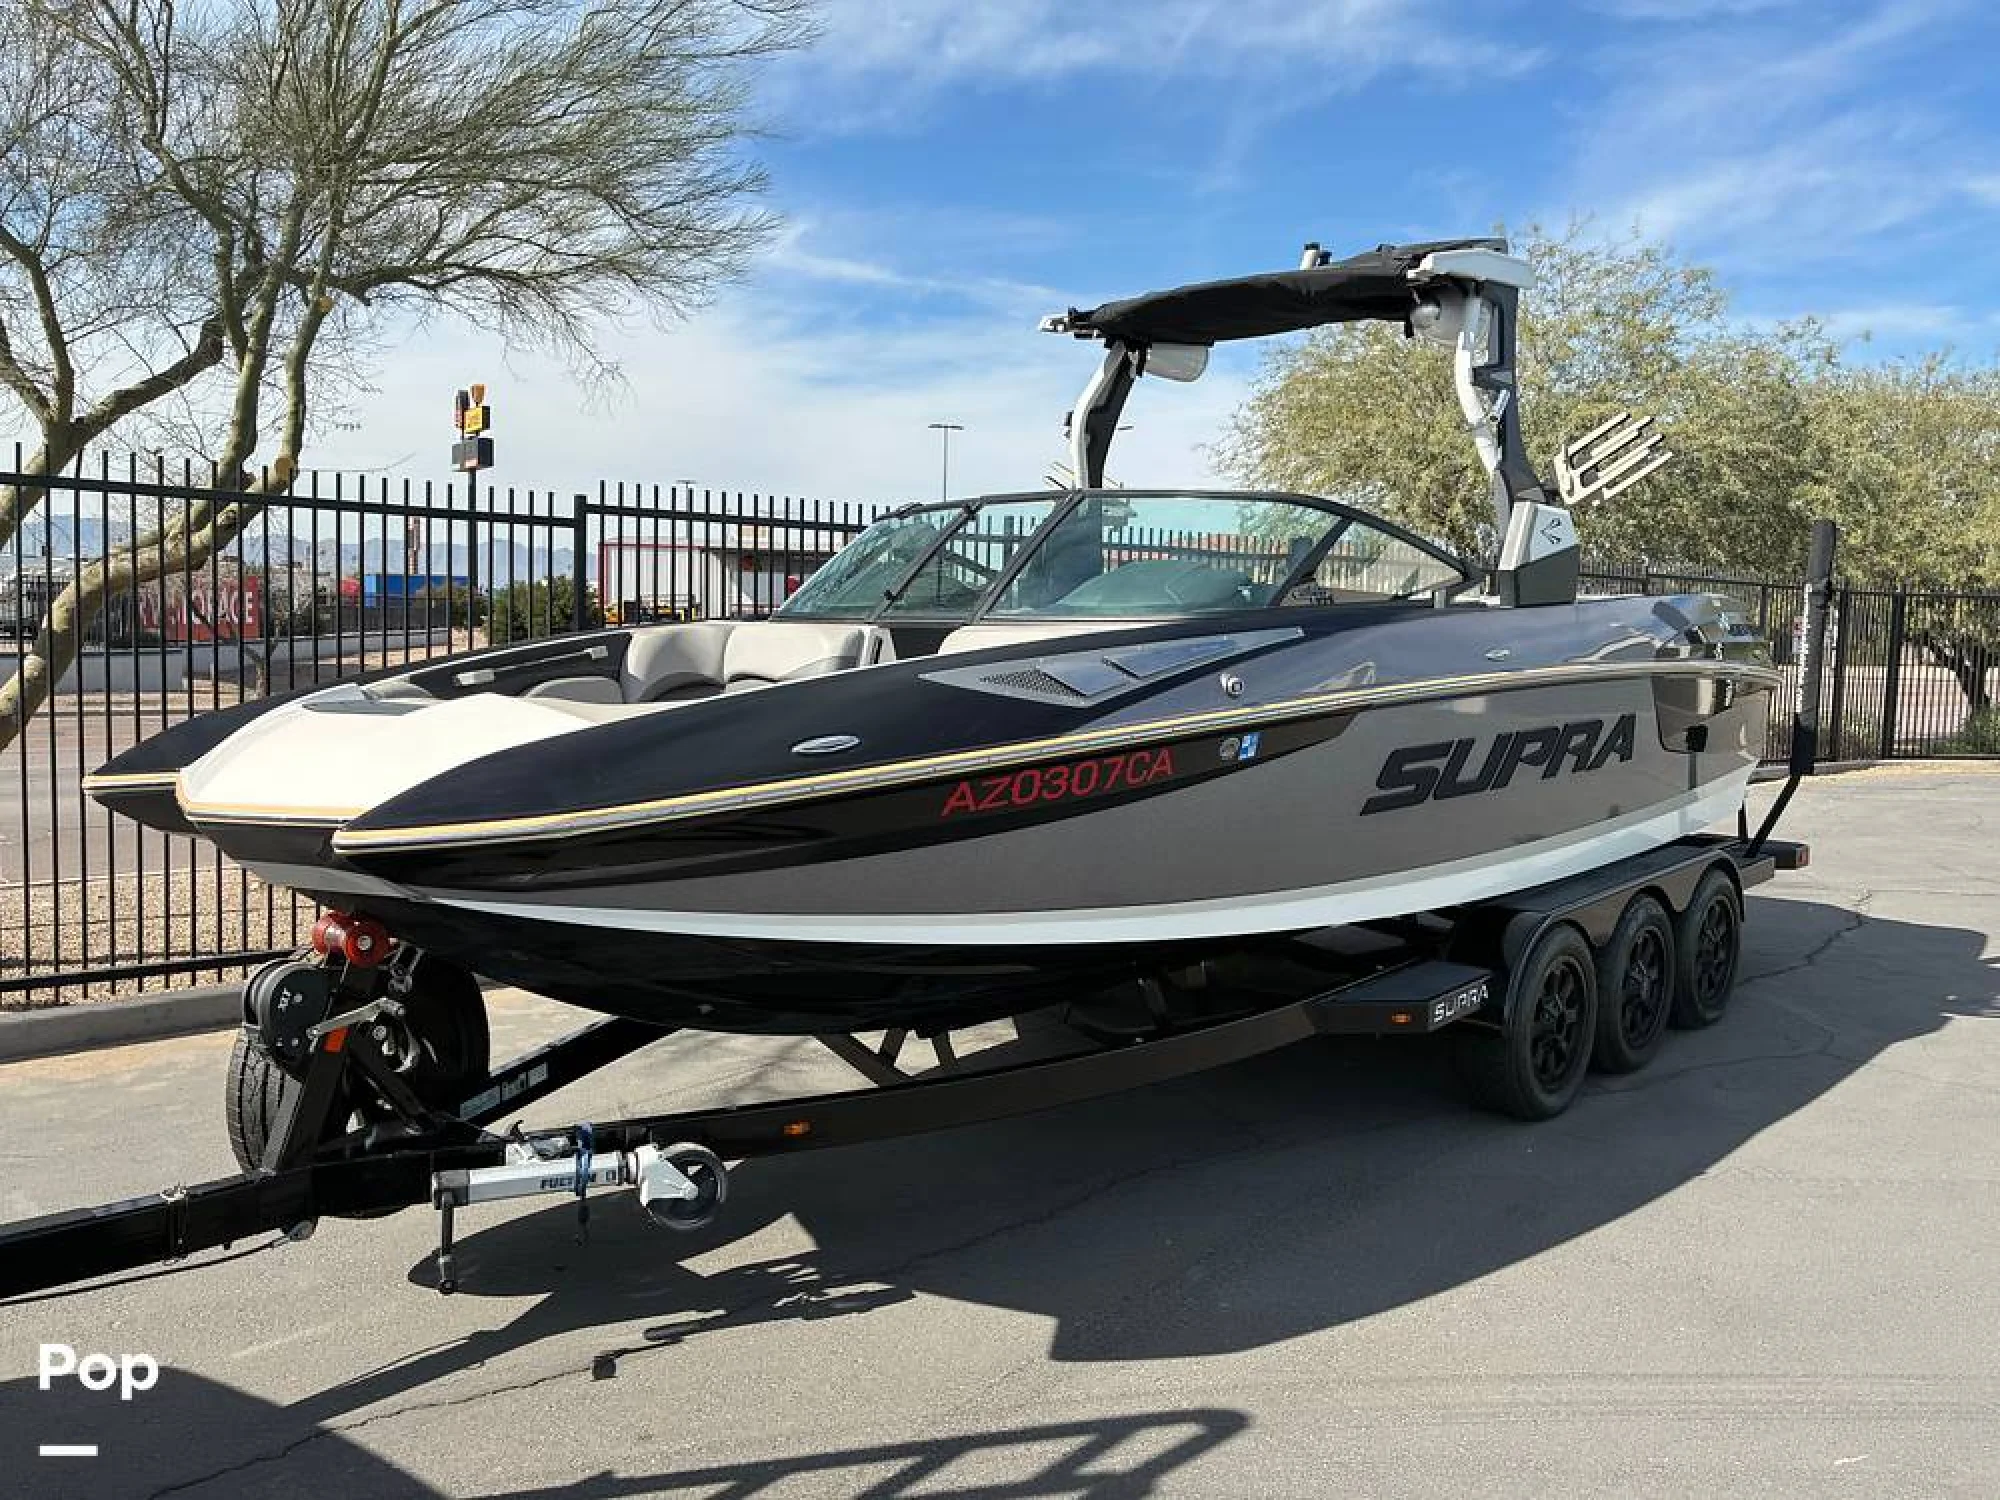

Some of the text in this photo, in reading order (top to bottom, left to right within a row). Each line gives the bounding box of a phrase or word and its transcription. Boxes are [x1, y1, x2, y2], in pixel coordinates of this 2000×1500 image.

[940, 748, 1174, 818] AZ0307CA
[1360, 703, 1636, 816] SUPRA
[1433, 985, 1489, 1023] SUPRA
